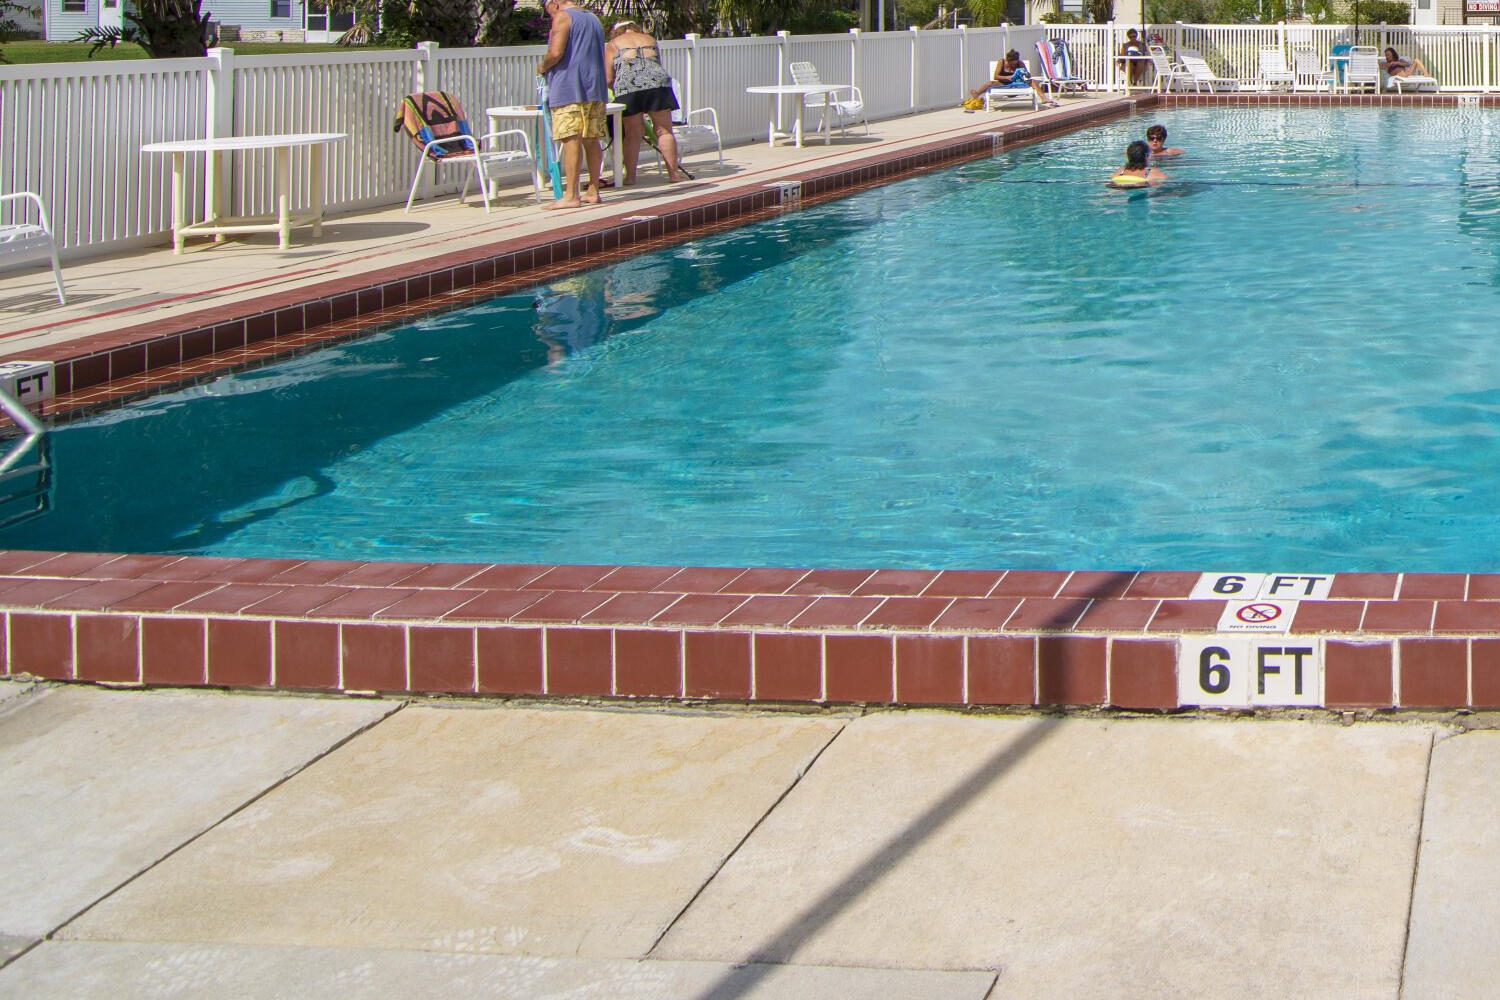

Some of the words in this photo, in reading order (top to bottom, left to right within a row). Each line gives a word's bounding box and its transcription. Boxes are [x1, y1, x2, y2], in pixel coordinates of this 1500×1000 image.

[17, 371, 48, 397] FT
[1213, 576, 1246, 594] 6
[1269, 576, 1326, 595] FT
[1200, 646, 1231, 695] 6
[1257, 647, 1312, 695] FT
